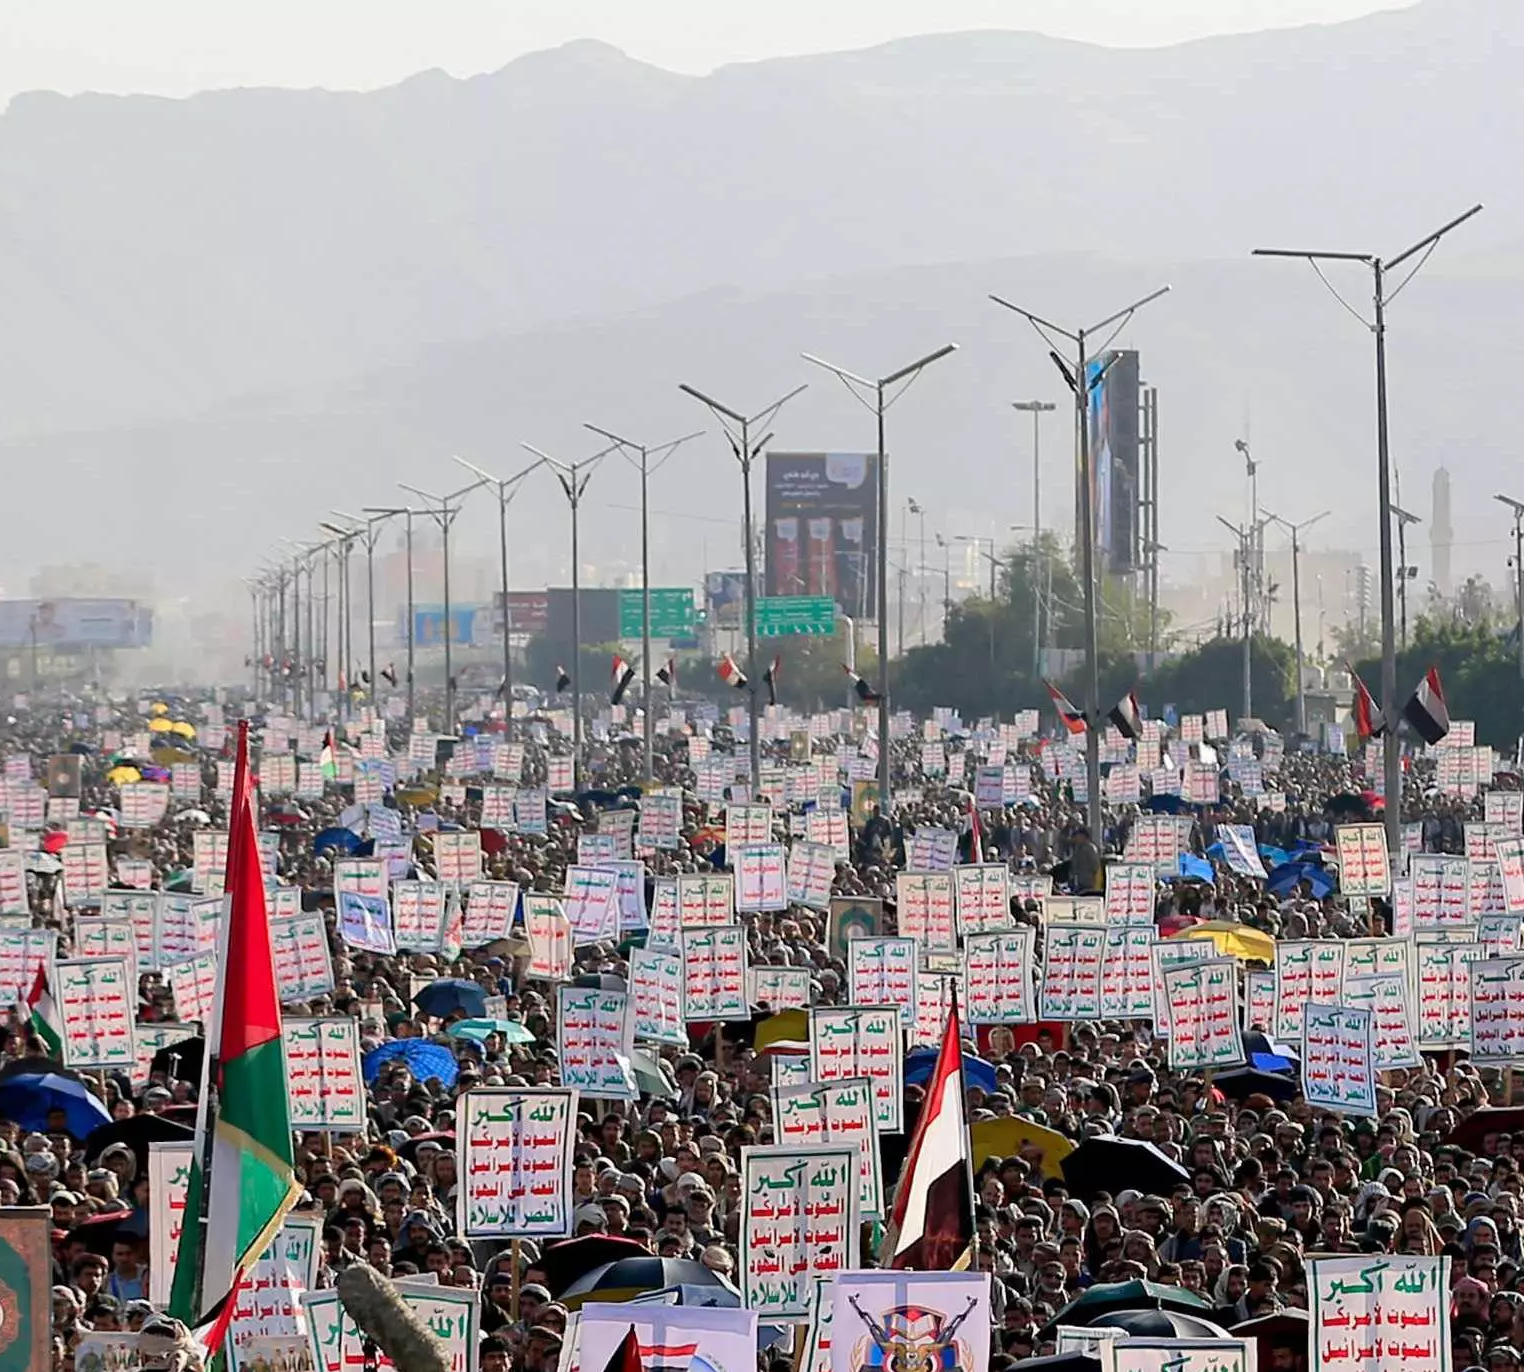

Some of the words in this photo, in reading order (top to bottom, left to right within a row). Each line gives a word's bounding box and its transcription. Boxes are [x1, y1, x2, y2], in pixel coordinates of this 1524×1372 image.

[1322, 1261, 1389, 1304] أكبر
[1395, 1263, 1436, 1293] الله
[1322, 1302, 1384, 1330] لأمريكا
[1387, 1307, 1436, 1329] الموت
[1386, 1340, 1436, 1361] الموت
